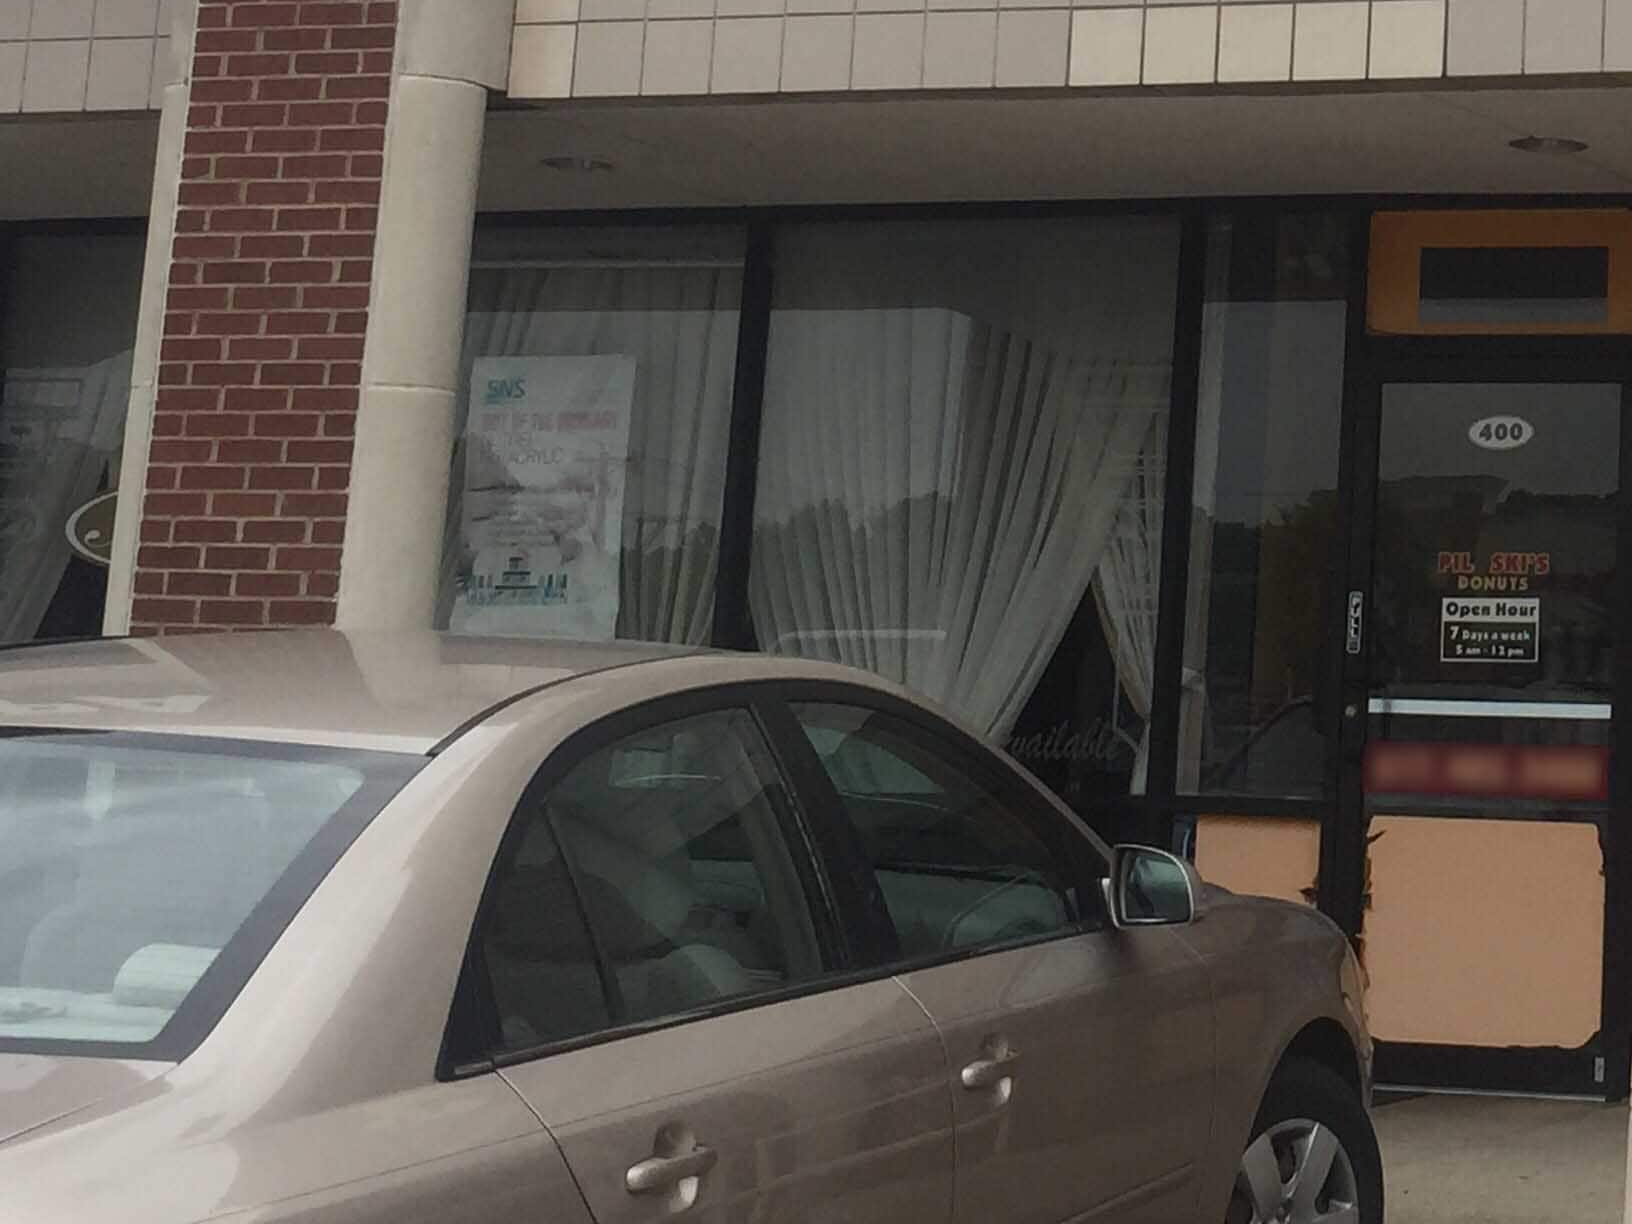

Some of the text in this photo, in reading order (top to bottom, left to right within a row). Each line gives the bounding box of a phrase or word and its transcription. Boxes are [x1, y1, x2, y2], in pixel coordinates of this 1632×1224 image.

[1479, 423, 1523, 441] 400
[1446, 602, 1537, 618] Open Hour
[1450, 625, 1459, 640] 7
[1501, 630, 1531, 641] week
[1008, 718, 1120, 762] vailable
